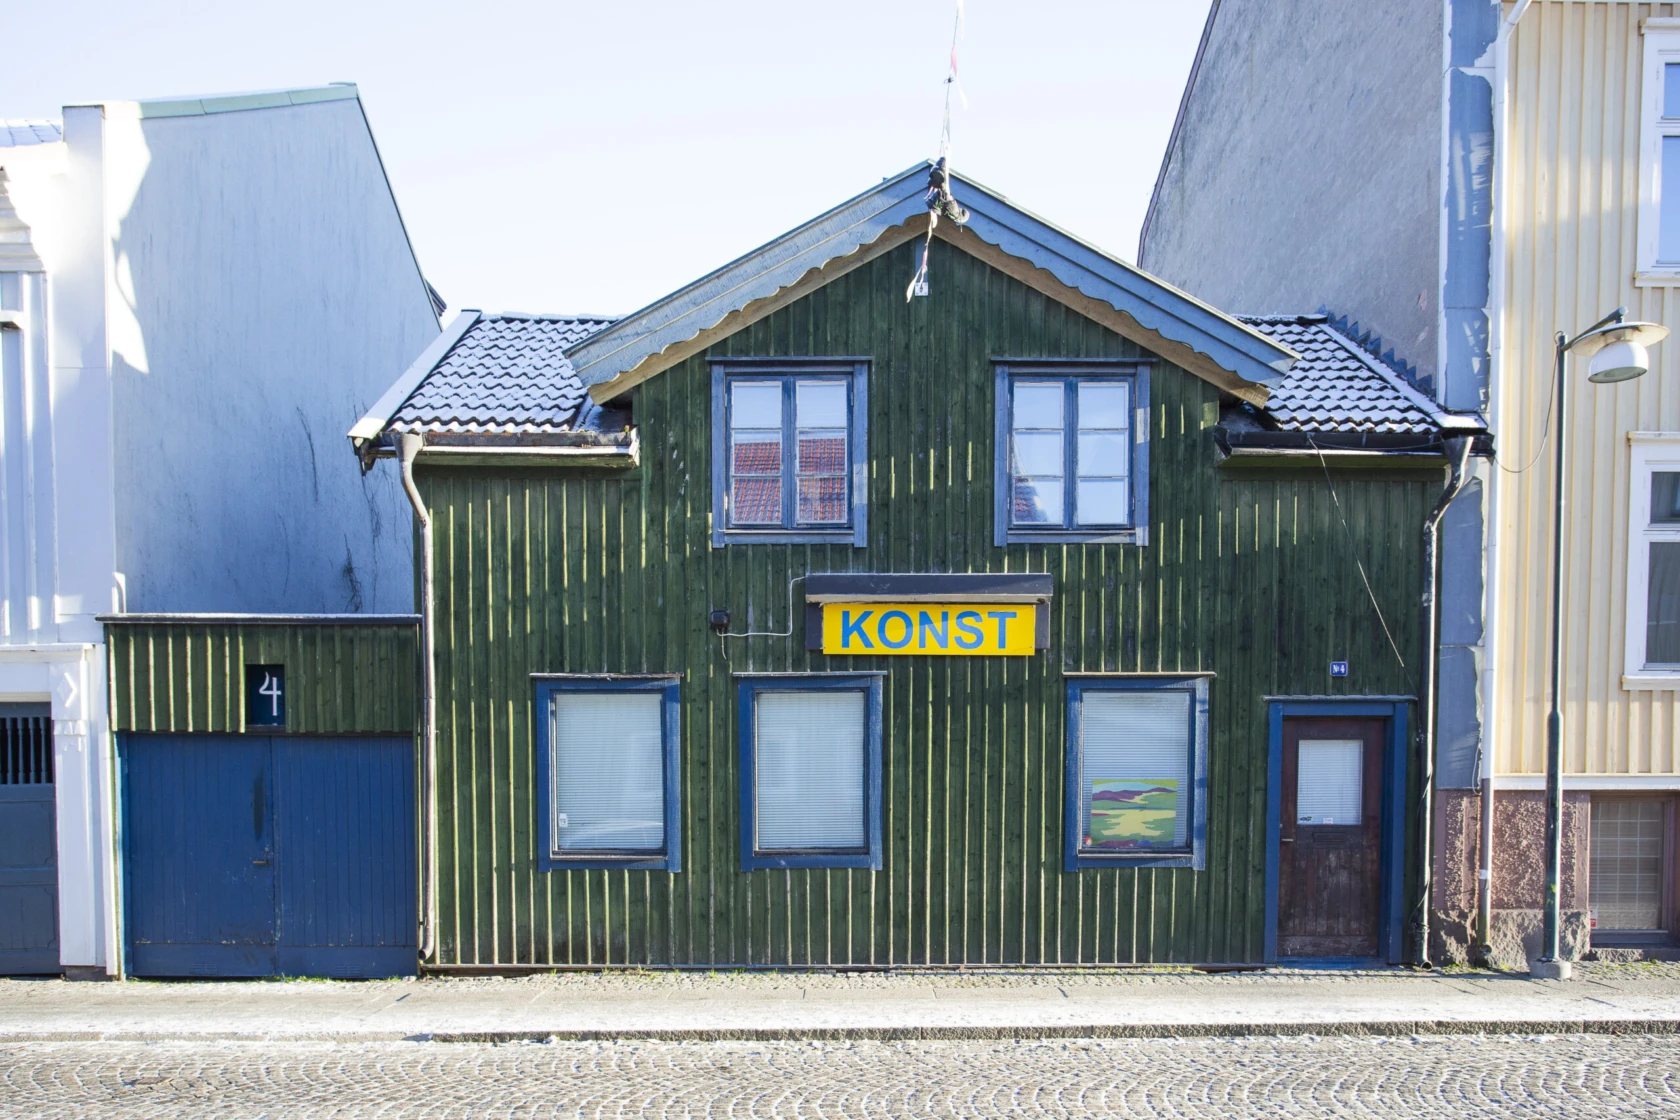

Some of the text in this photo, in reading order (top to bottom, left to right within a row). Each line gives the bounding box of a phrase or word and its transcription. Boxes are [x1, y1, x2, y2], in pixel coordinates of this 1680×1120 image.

[841, 610, 1017, 649] KONST
[1340, 664, 1345, 674] 4
[259, 671, 282, 716] 4
